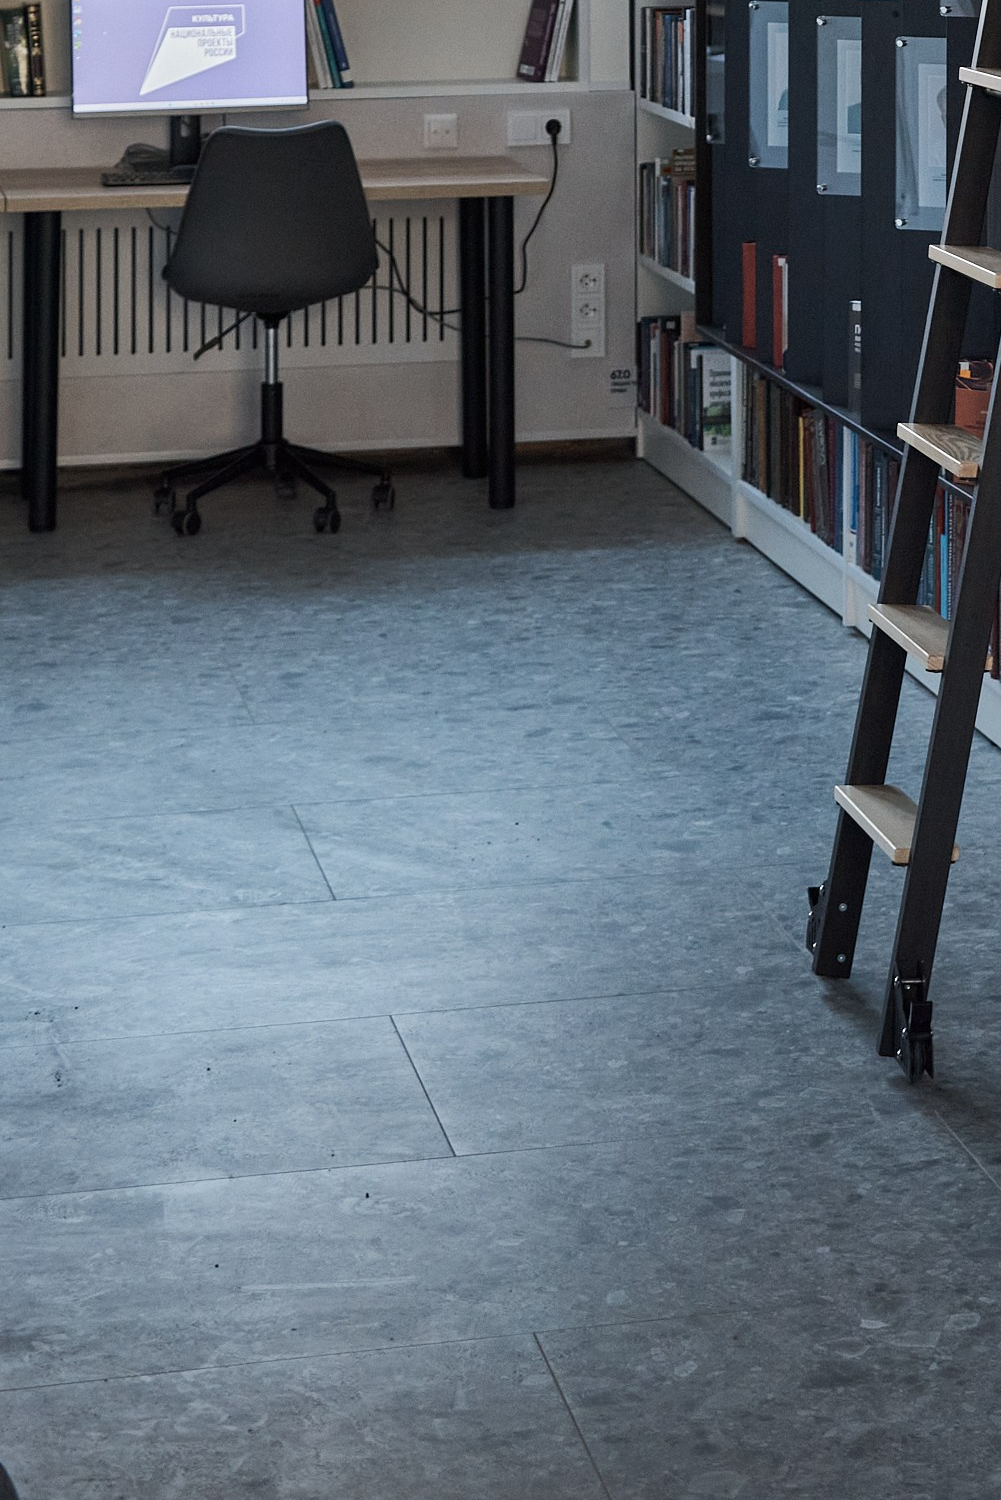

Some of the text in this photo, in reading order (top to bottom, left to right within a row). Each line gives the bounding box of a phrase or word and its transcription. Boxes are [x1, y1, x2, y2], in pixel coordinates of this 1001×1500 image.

[192, 13, 235, 23] КУЛЬТУРА
[170, 27, 232, 39] НАЦИОНАЛЬНЫЕ
[197, 38, 233, 48] ПРОЕКТЫ
[204, 48, 233, 57] РОССИИ
